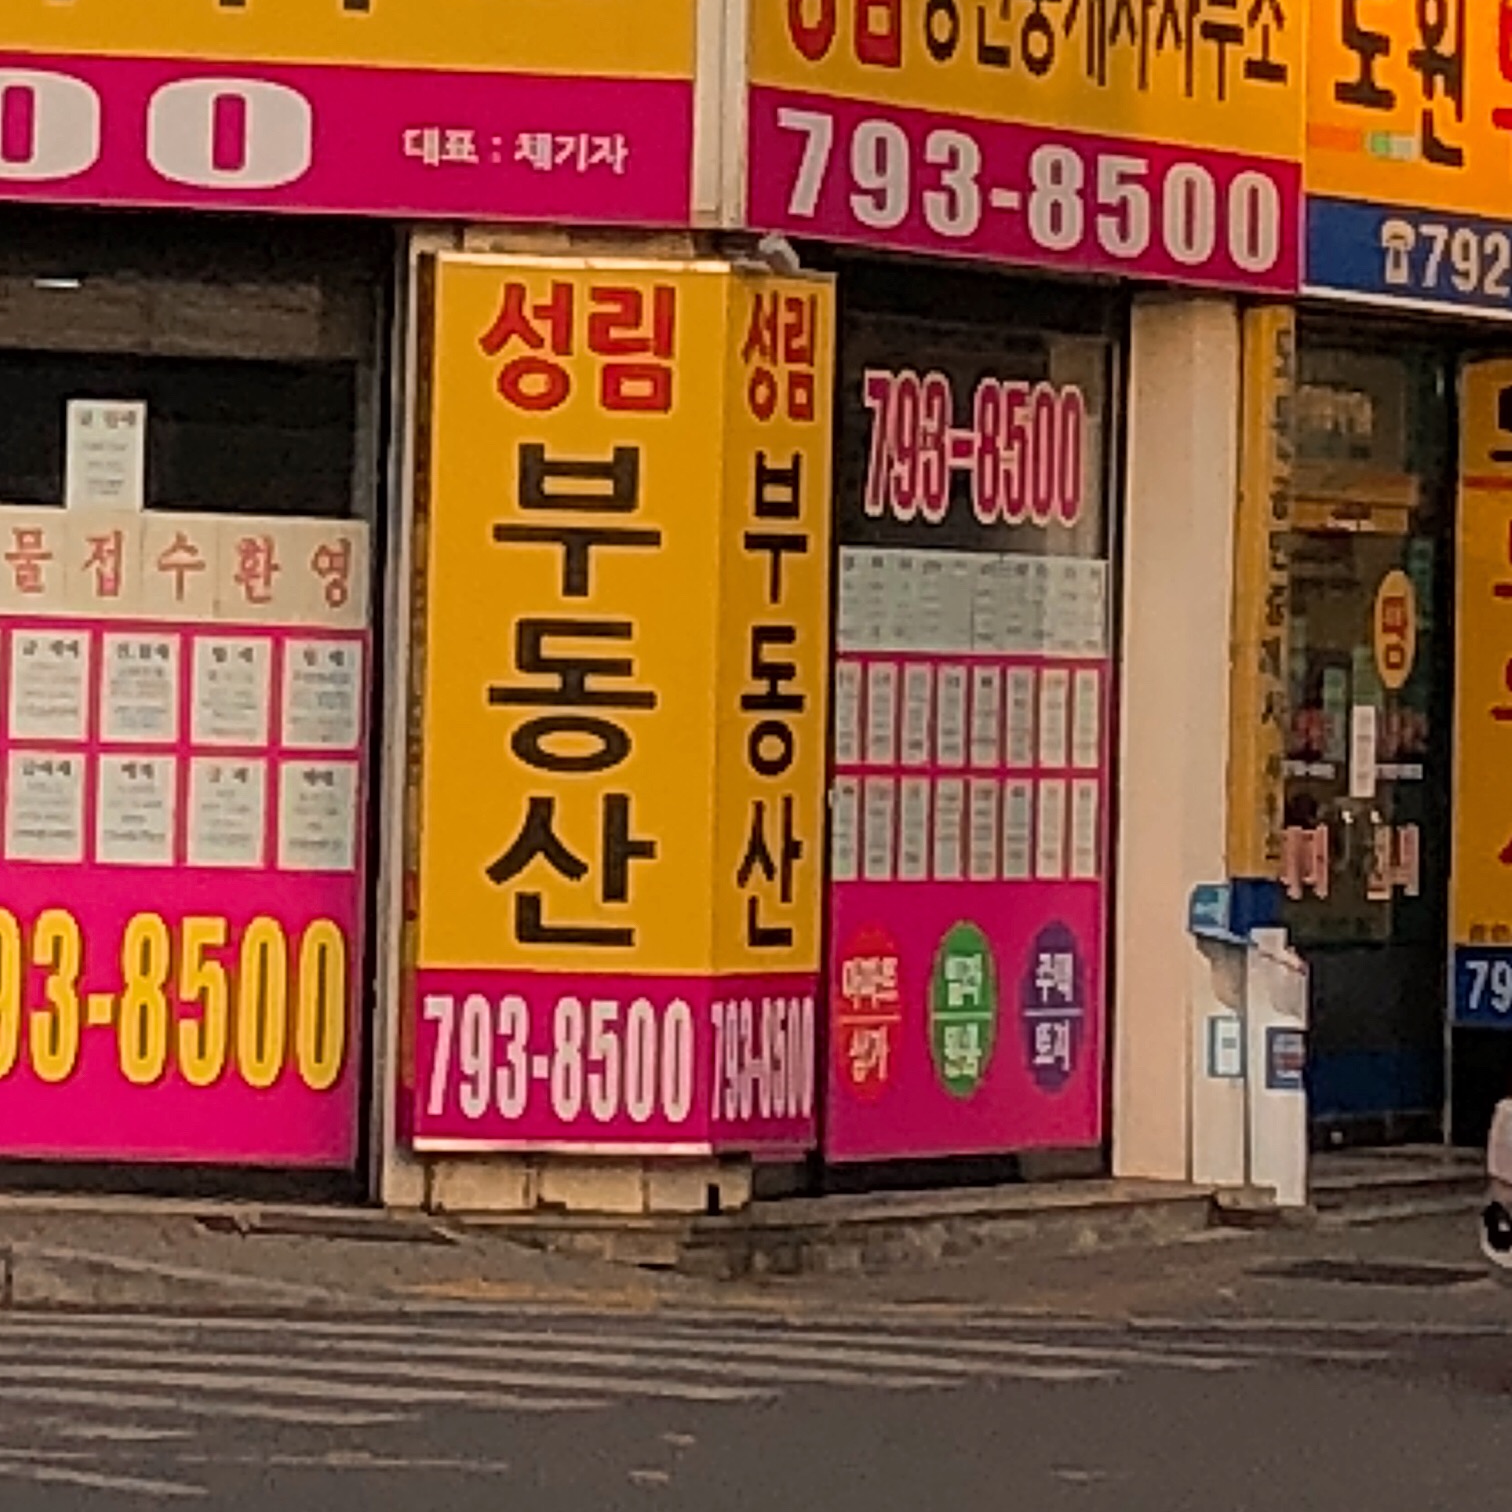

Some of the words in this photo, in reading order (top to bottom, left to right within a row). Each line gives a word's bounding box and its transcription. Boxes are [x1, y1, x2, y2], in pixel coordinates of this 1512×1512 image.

[402, 127, 480, 168] 대표
[777, 106, 1282, 274] 793-8500
[478, 279, 678, 413] 성림
[740, 289, 819, 423] 성림
[862, 368, 1086, 528] 793-8500
[485, 442, 662, 947] 부동산
[737, 450, 809, 948] 부동산
[422, 994, 695, 1123] 793-8500
[710, 995, 816, 1123] 793-8500
